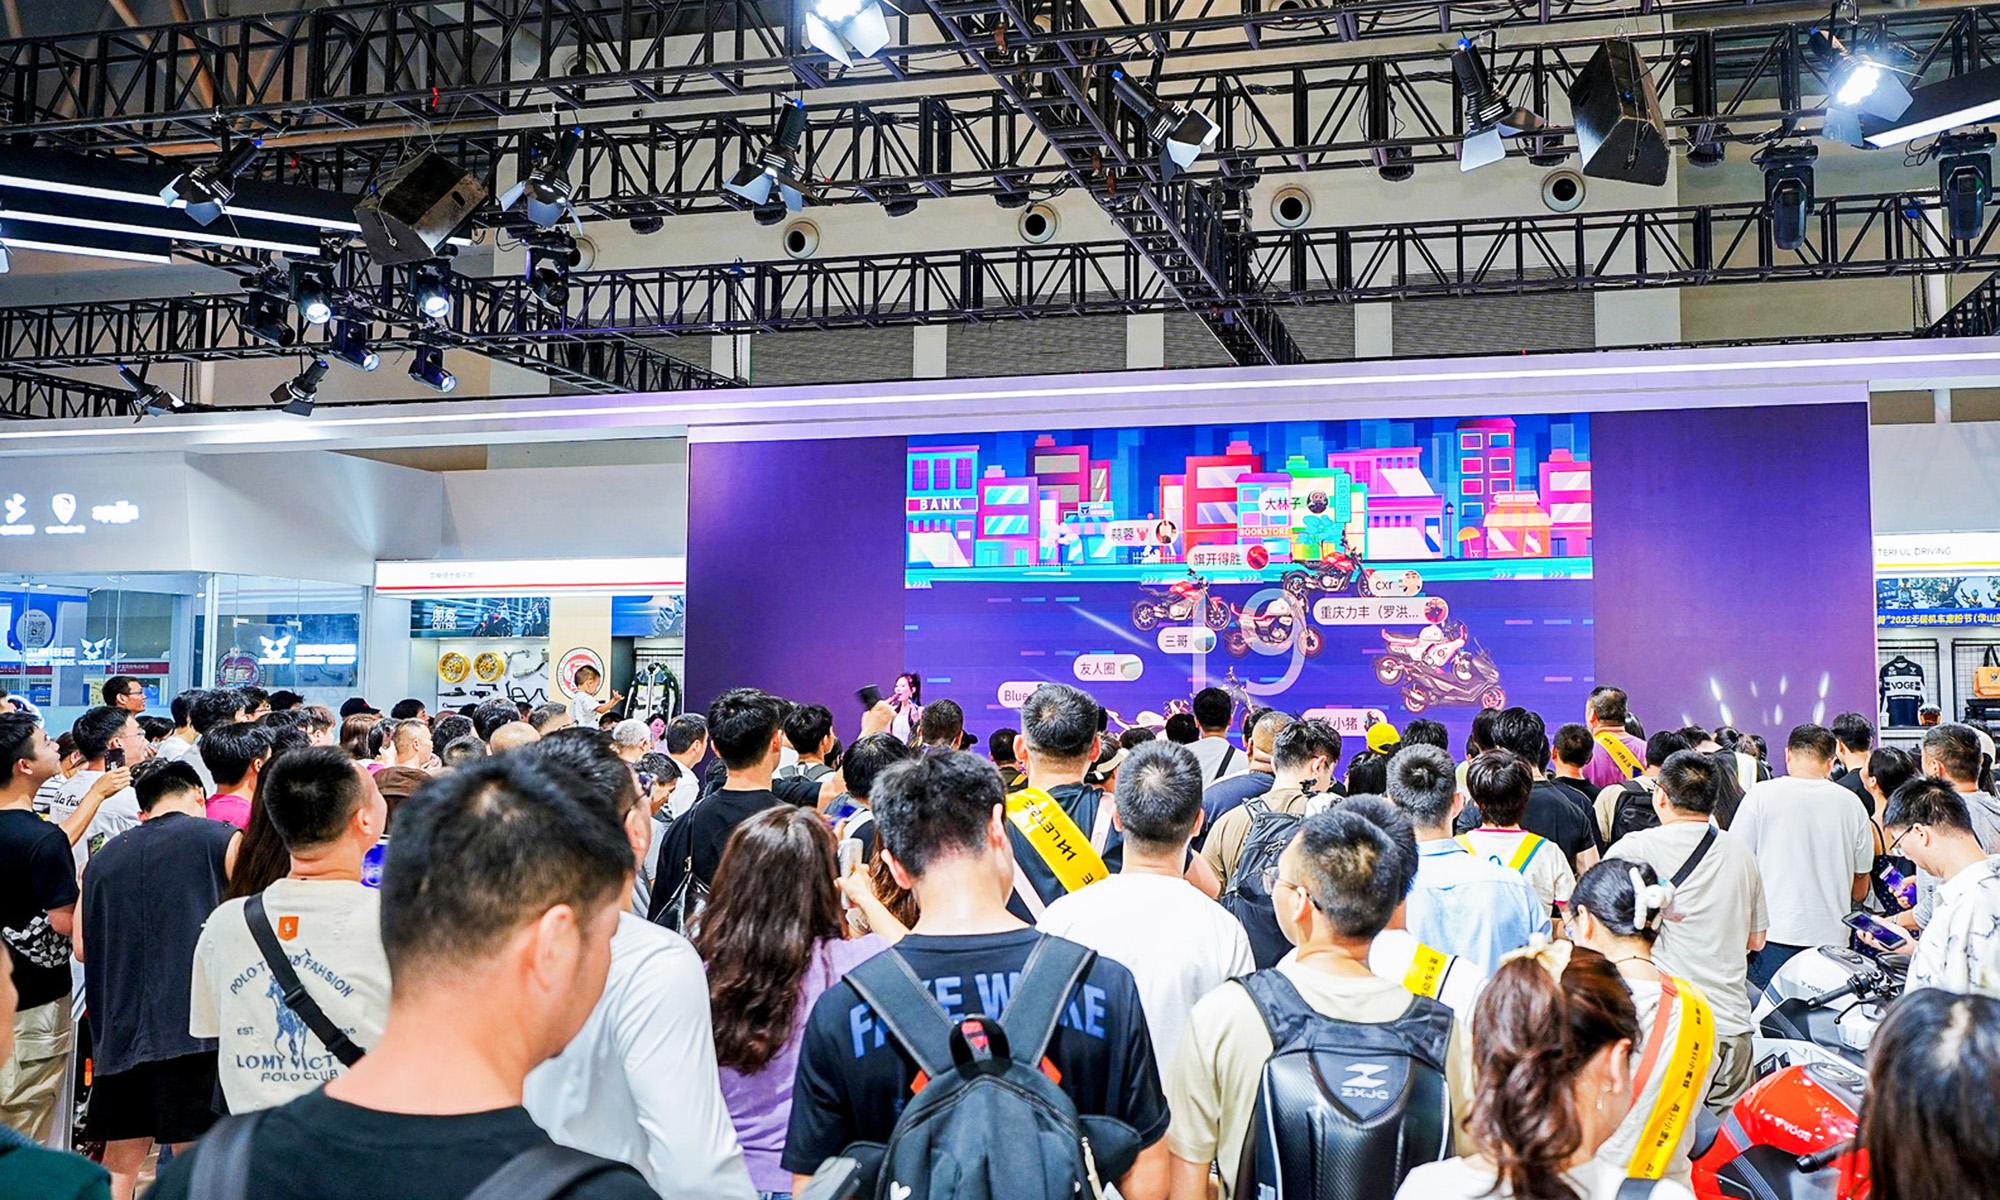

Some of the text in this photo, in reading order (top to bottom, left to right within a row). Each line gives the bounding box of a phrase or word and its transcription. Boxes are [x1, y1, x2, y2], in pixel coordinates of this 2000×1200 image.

[1338, 476, 1350, 518] HOTEL
[920, 498, 962, 510] BANK
[1265, 497, 1301, 511] 大林子
[1112, 528, 1134, 541] 蒜蓉
[1239, 526, 1290, 537] BOOKSTORE
[1914, 546, 1952, 556] DRIVING
[1194, 552, 1242, 566] 旗开得胜
[1165, 635, 1188, 648] 三哥
[1192, 588, 1307, 696] 19
[1080, 661, 1116, 675] 友人圈
[1890, 681, 1915, 690] VOGE
[230, 966, 258, 995] POLO
[304, 959, 355, 998] FAHSION
[237, 1026, 254, 1035] EST
[236, 1054, 286, 1070] LOMY
[261, 1069, 340, 1082] POLO CLUB
[1783, 1120, 1813, 1143] VOGE
